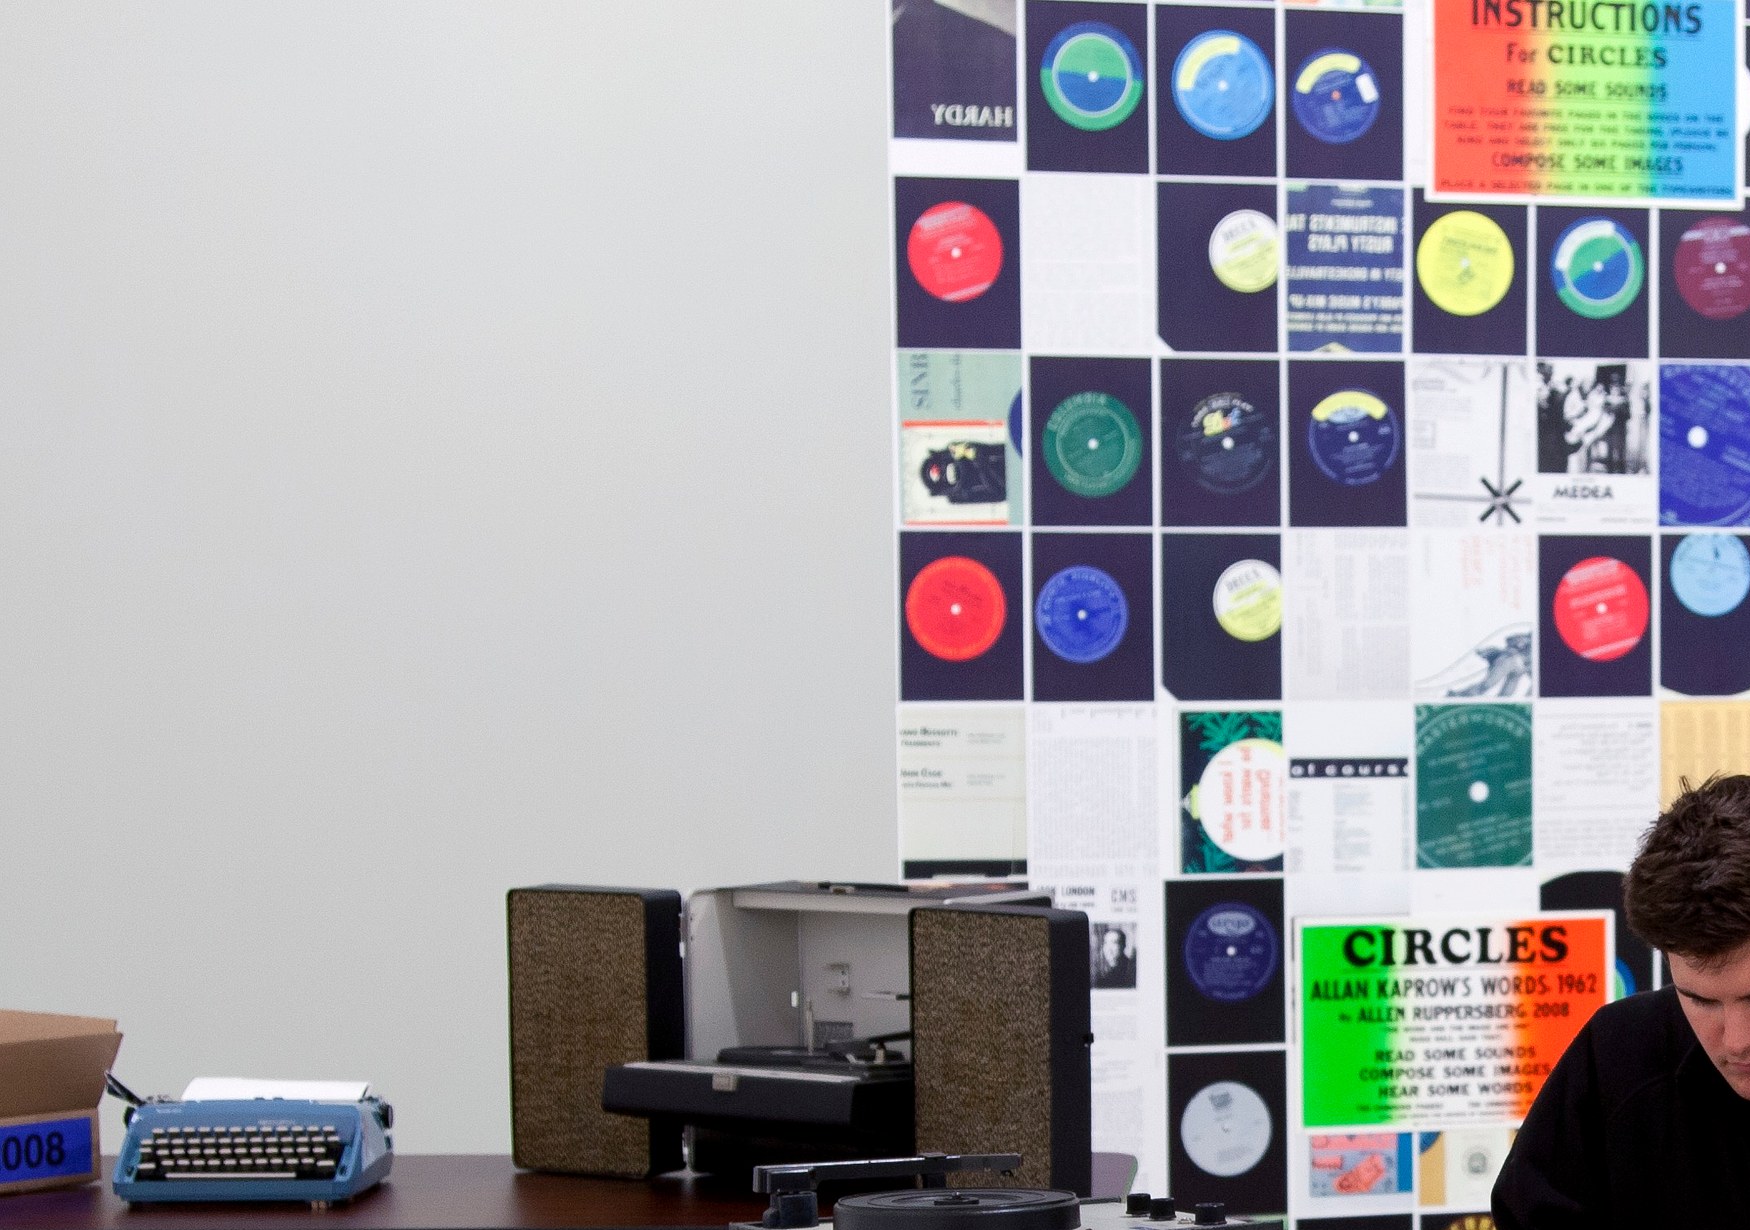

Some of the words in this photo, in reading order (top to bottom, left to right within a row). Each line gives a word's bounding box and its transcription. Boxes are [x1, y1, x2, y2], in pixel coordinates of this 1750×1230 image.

[1471, 0, 1703, 34] INSTRUCTIONS
[1507, 43, 1537, 64] For
[1548, 44, 1668, 68] CIRCLES
[1556, 81, 1596, 97] SOME
[1493, 151, 1565, 171] COMPOSE
[1575, 153, 1616, 171] SOME
[1625, 154, 1684, 174] IMAGES
[1341, 925, 1569, 969] CIRCLES
[1310, 977, 1370, 1002] ALLAN
[1375, 974, 1472, 1000] KAPROW'S
[1557, 972, 1599, 994] 1962
[1356, 1007, 1405, 1024] ALLEN
[1412, 1003, 1527, 1021] RUPPERSBERG
[1533, 1001, 1571, 1018] 2008
[1374, 1049, 1415, 1063] READ
[1423, 1047, 1466, 1062] SOME
[1474, 1045, 1537, 1060] SOUNDS
[1358, 1066, 1436, 1082] COMPOSE
[1442, 1064, 1486, 1079] SOME
[1493, 1062, 1552, 1077] IMAGES
[1377, 1083, 1419, 1099] HEAR
[1427, 1082, 1470, 1098] SOME
[1477, 1081, 1533, 1096] WORDS
